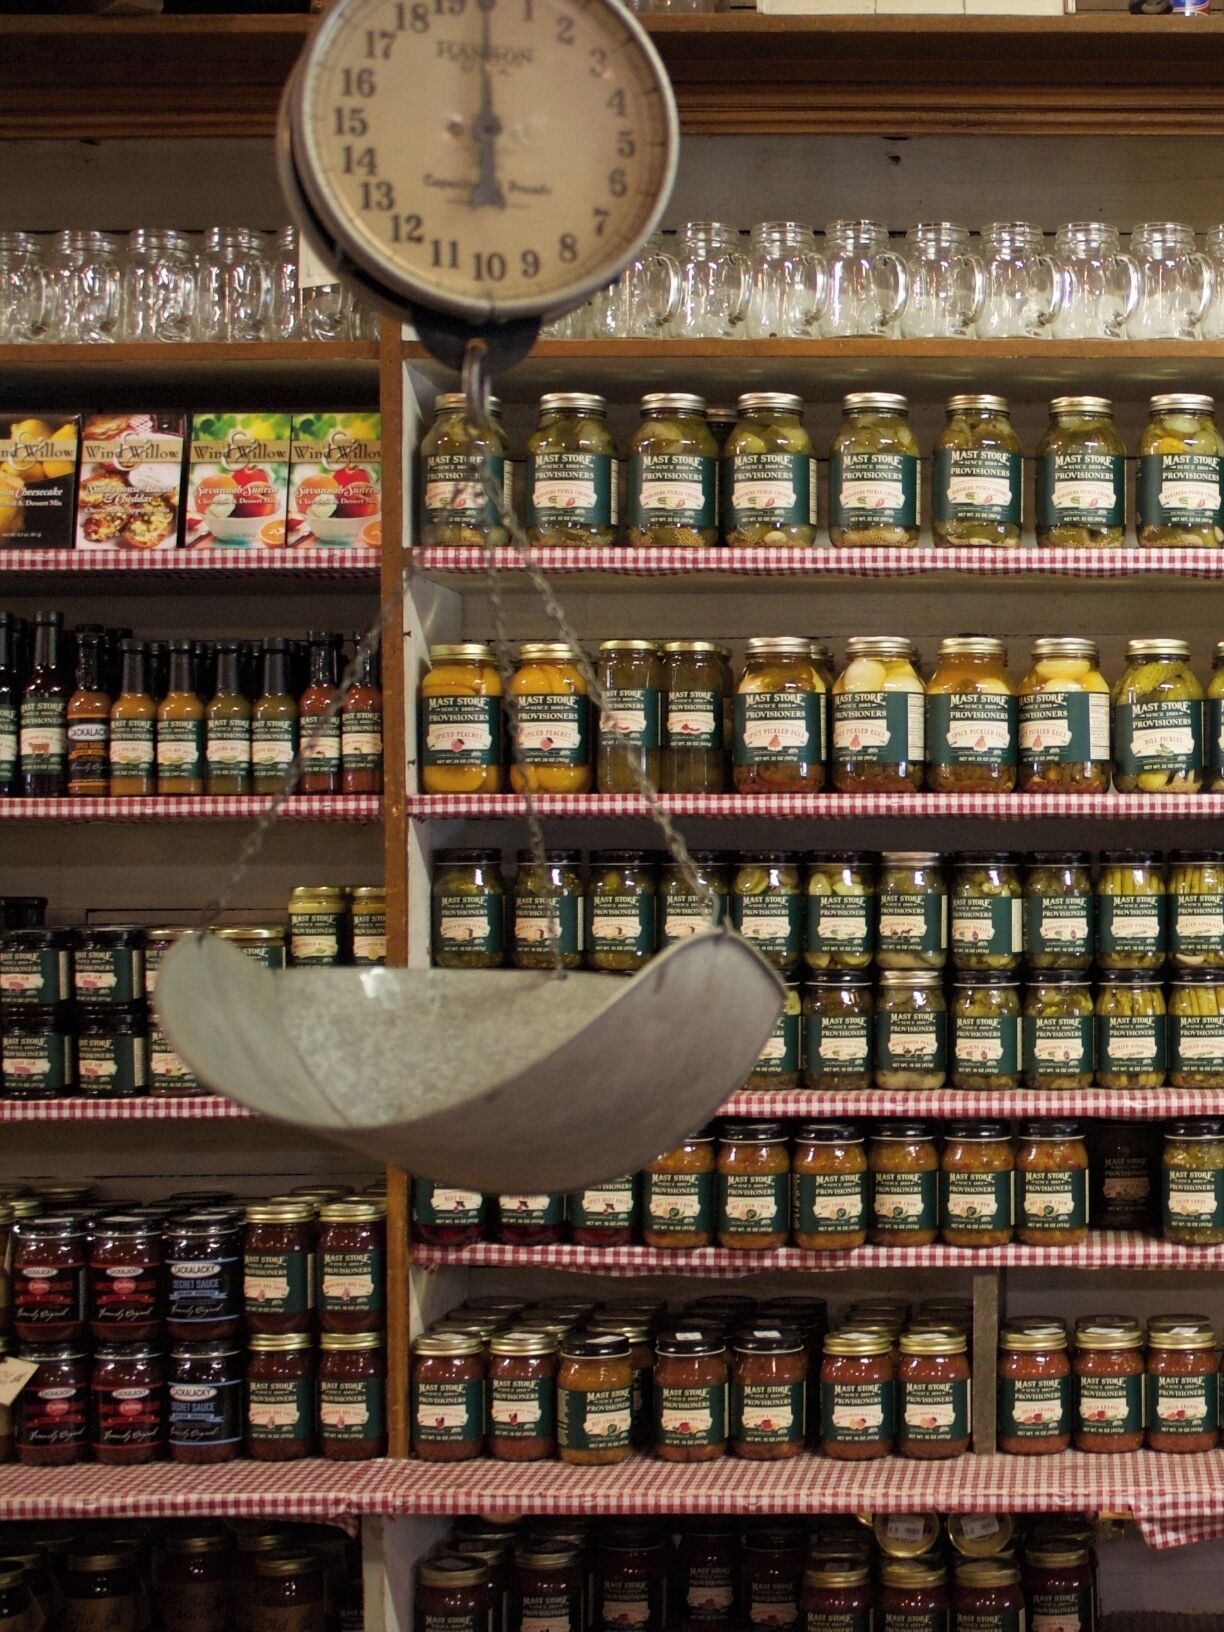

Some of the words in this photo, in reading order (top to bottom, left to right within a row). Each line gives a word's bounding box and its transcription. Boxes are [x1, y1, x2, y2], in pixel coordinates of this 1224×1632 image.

[394, 4, 429, 34] 18
[557, 17, 575, 45] 2
[364, 30, 397, 59] 17
[589, 49, 609, 77] 3
[342, 68, 375, 98] 16
[607, 89, 625, 115] 4
[333, 107, 368, 136] 15
[617, 131, 635, 158] 5
[343, 146, 377, 176] 14
[360, 182, 393, 211] 13
[609, 170, 627, 197] 6
[391, 215, 422, 244] 12
[593, 208, 608, 235] 7
[431, 241, 459, 268] 11
[559, 234, 577, 262] 8
[473, 253, 505, 281] 10
[522, 250, 539, 278] 9
[535, 455, 563, 467] MAST
[567, 455, 594, 467] STORE
[843, 454, 869, 466] MAST
[872, 454, 902, 466] STORE
[951, 451, 978, 462] MAST
[981, 451, 1011, 464] STORE
[535, 472, 594, 480] PROVISIONERS
[843, 472, 902, 480] PROVISIONERS
[951, 468, 1010, 477] PROVISIONERS
[429, 698, 456, 709] MAST
[459, 698, 487, 709] STORE
[429, 714, 489, 722] PROVISIONERS
[1014, 1379, 1036, 1389] MAST
[1039, 1378, 1061, 1389] STORE
